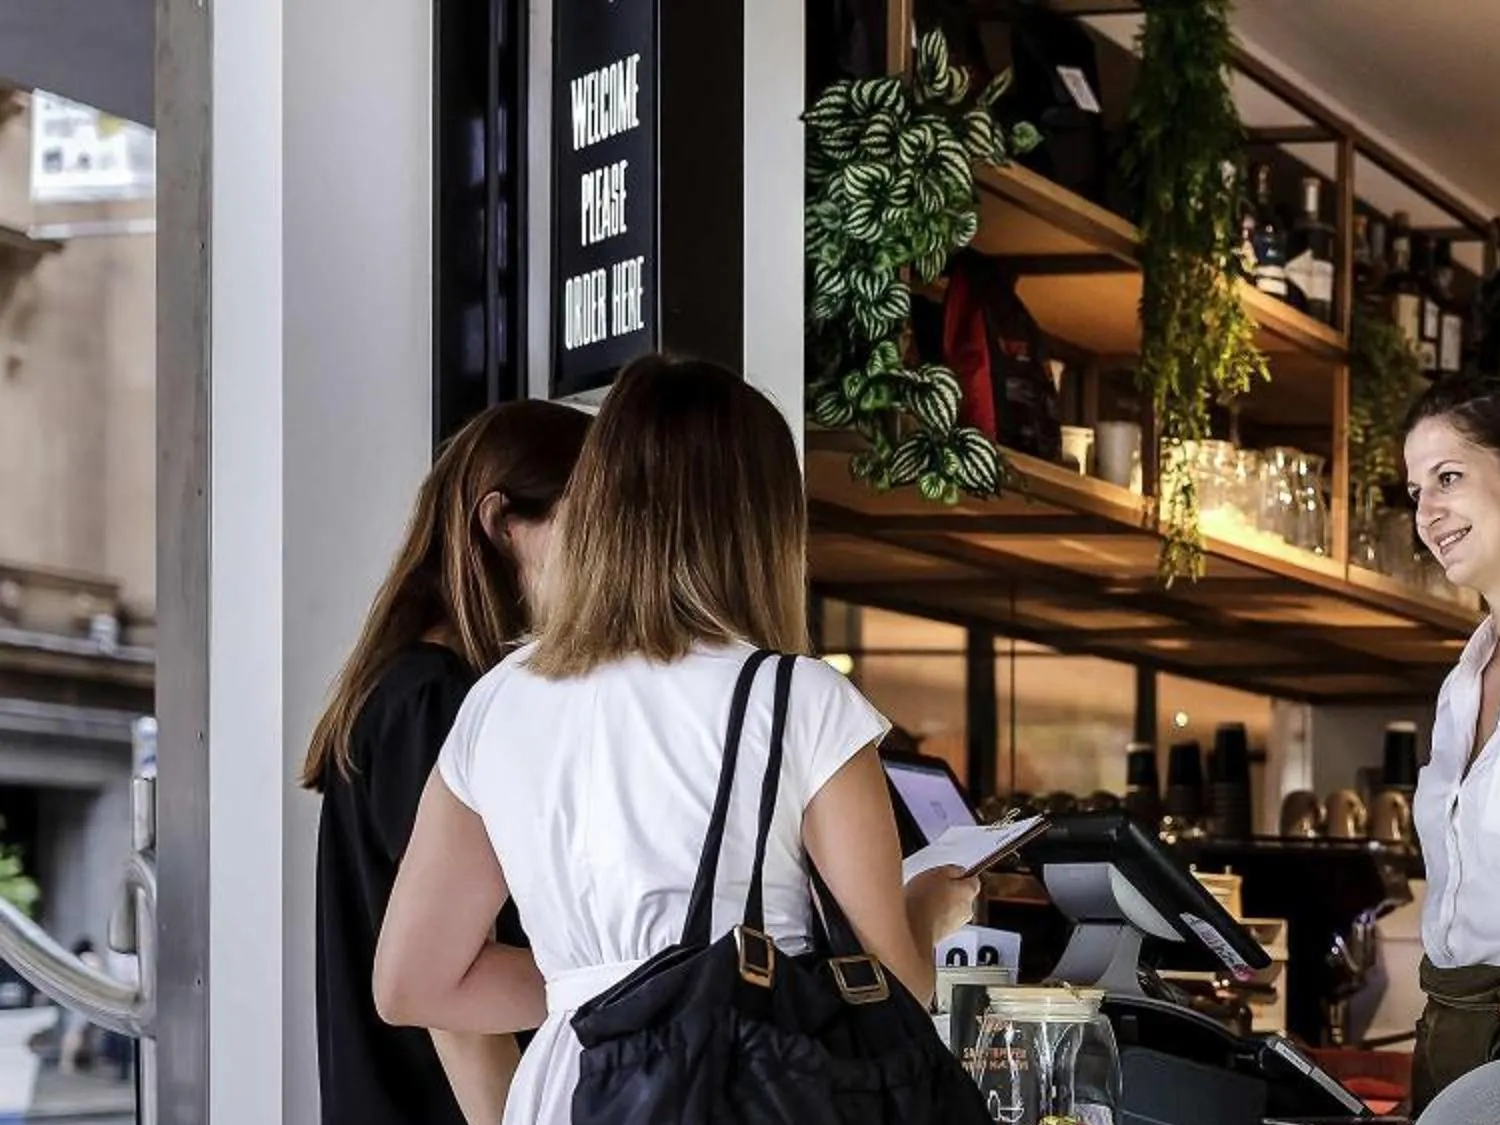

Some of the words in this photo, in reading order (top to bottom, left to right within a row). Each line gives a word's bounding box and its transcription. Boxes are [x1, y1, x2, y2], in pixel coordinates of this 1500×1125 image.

[571, 53, 641, 151] WELCOME
[581, 160, 629, 247] PLEASE
[565, 268, 607, 350] ORDER
[612, 255, 645, 336] HERE
